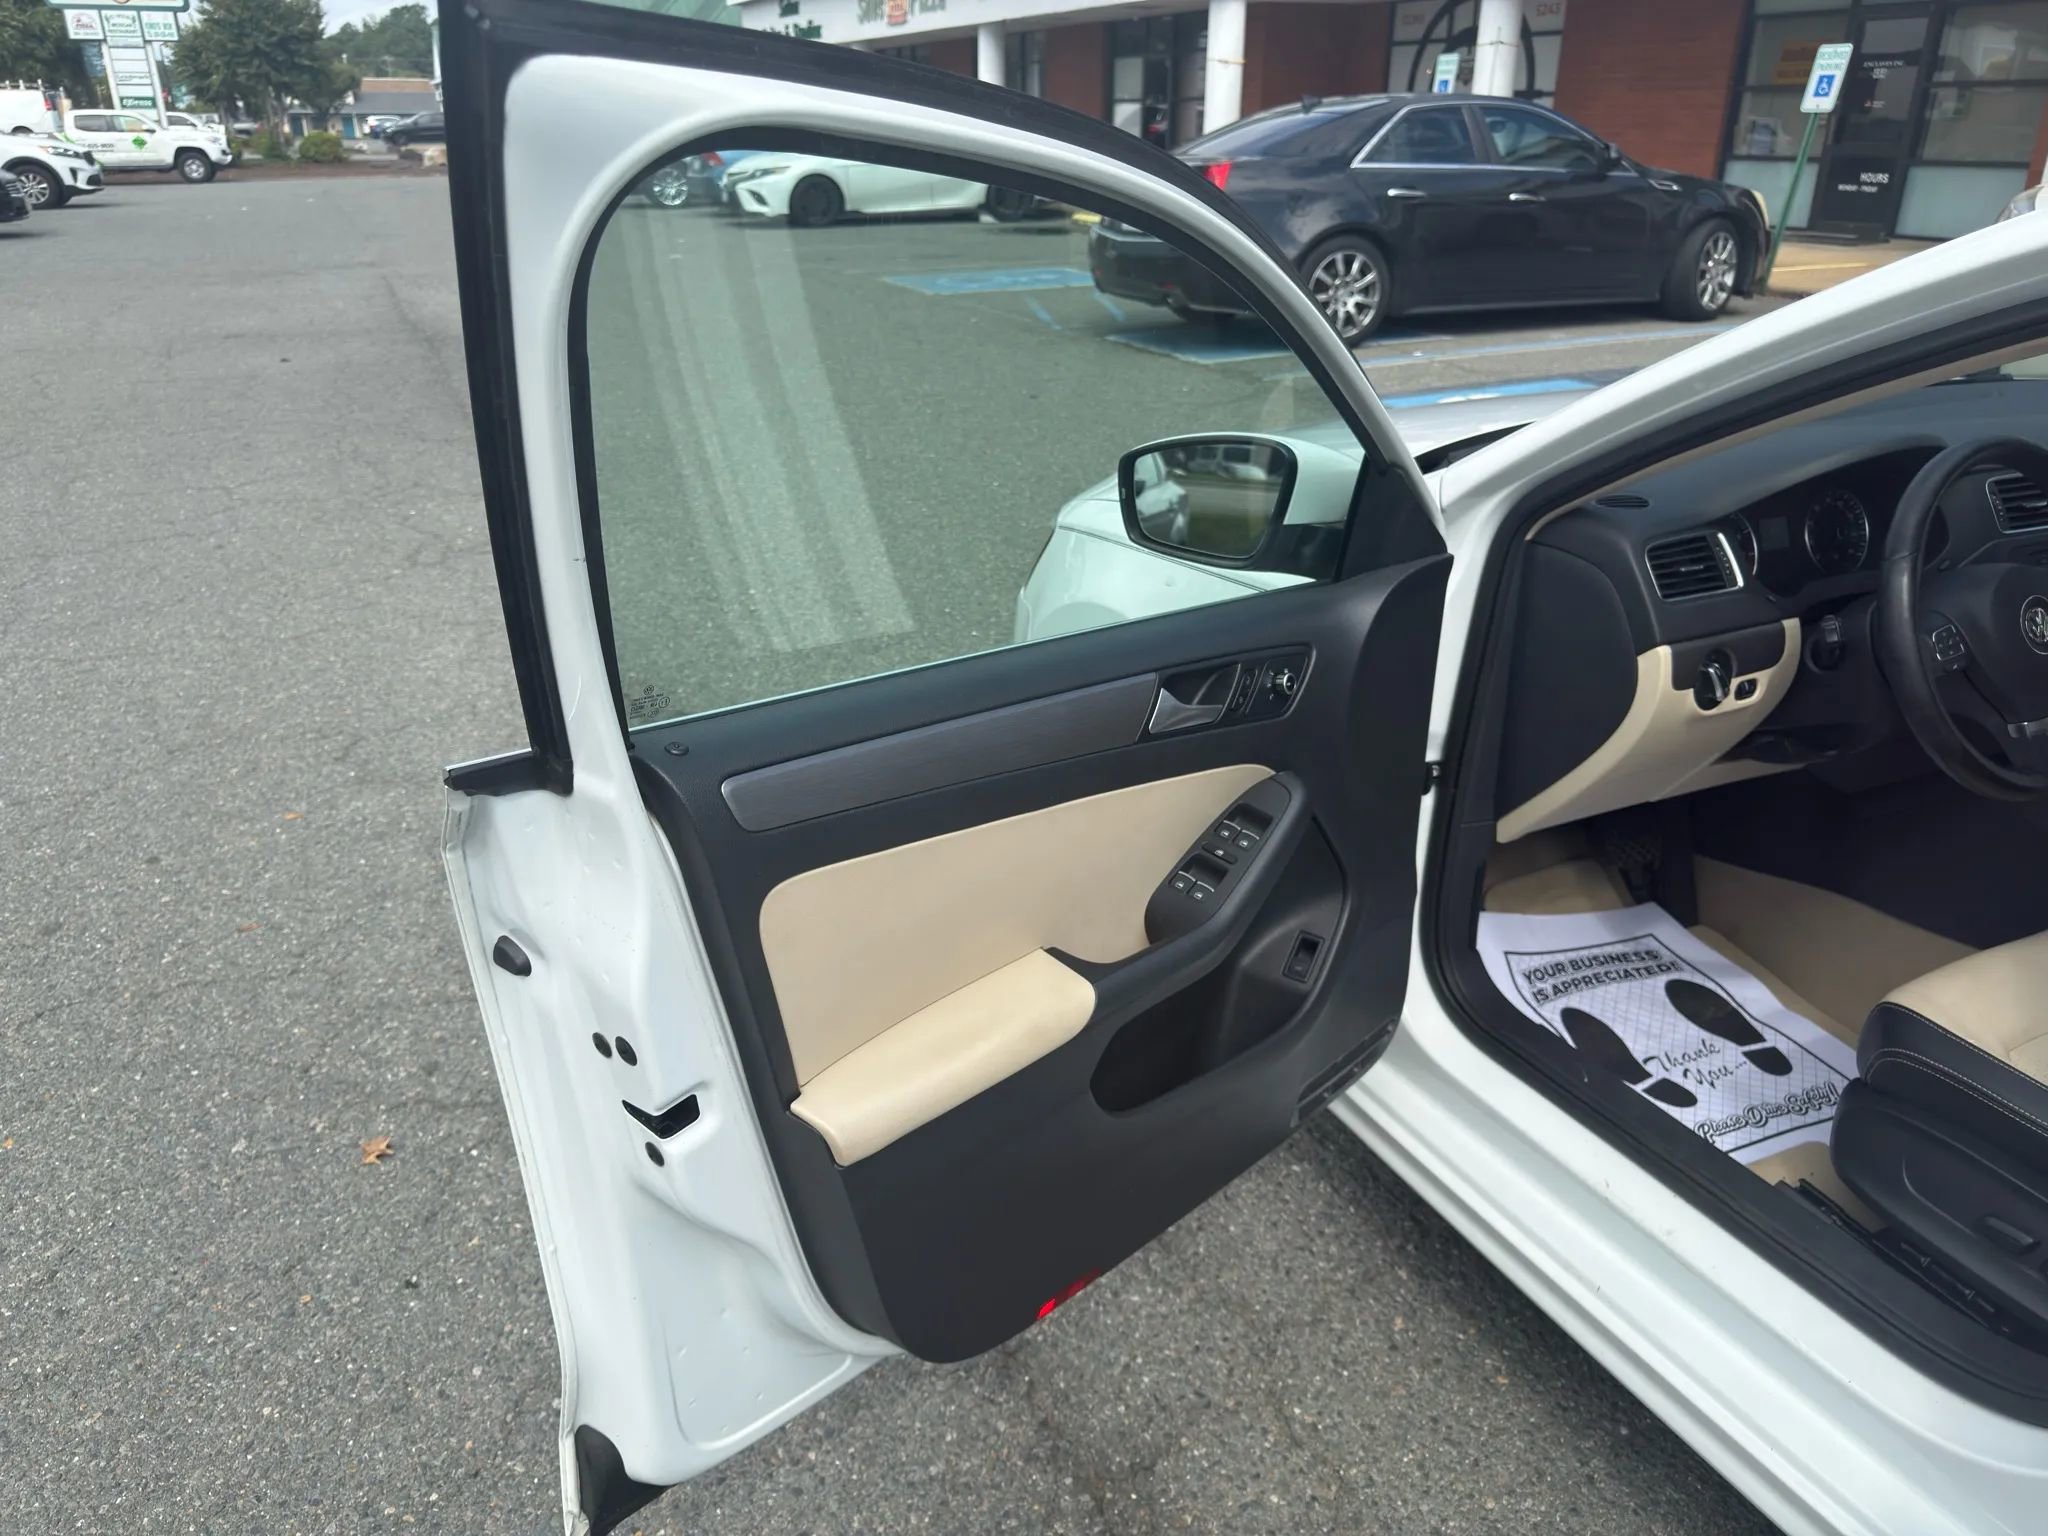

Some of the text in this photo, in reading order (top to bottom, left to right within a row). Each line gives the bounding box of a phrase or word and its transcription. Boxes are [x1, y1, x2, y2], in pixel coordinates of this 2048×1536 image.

[1860, 172, 1889, 184] HOURS
[1522, 949, 1661, 985] YOUR BUSINESS
[1531, 988, 1550, 1004] IS
[1643, 1038, 1721, 1073] Thank
[1694, 1115, 1748, 1144] Please
[1743, 1103, 1789, 1128] Drive
